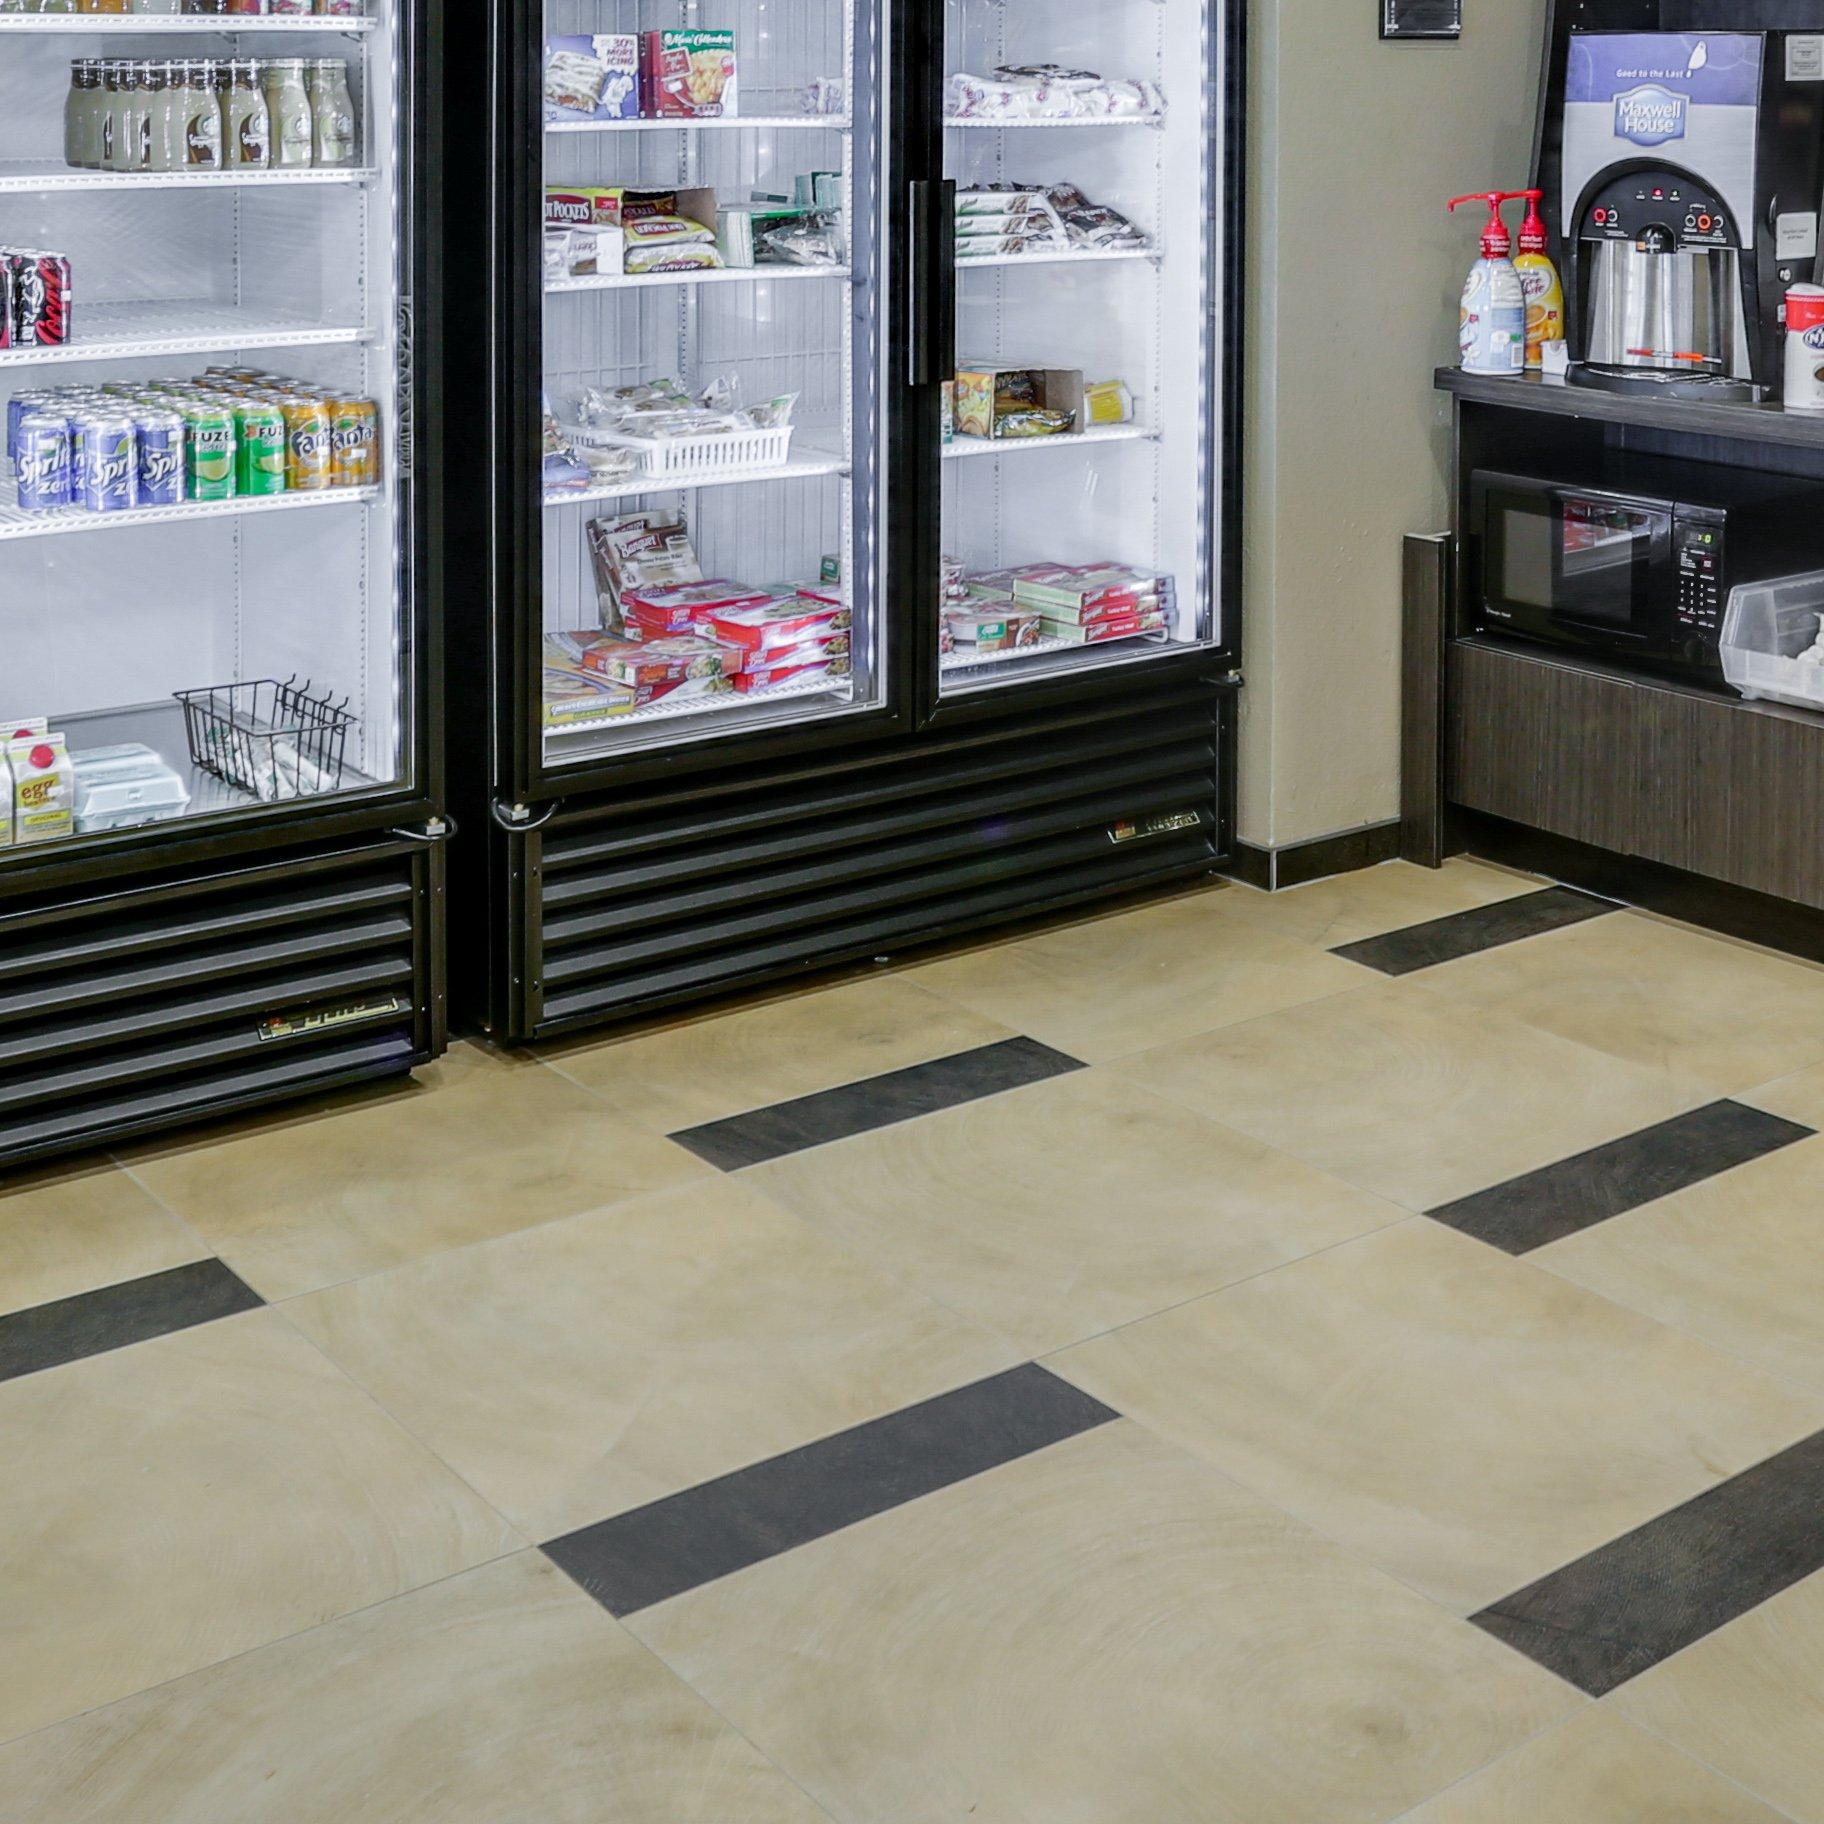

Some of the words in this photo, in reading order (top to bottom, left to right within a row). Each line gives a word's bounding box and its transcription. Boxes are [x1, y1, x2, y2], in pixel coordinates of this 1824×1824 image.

[1638, 69, 1648, 78] to
[1649, 69, 1664, 78] the
[1618, 99, 1682, 119] Maxwell
[1624, 116, 1675, 134] House
